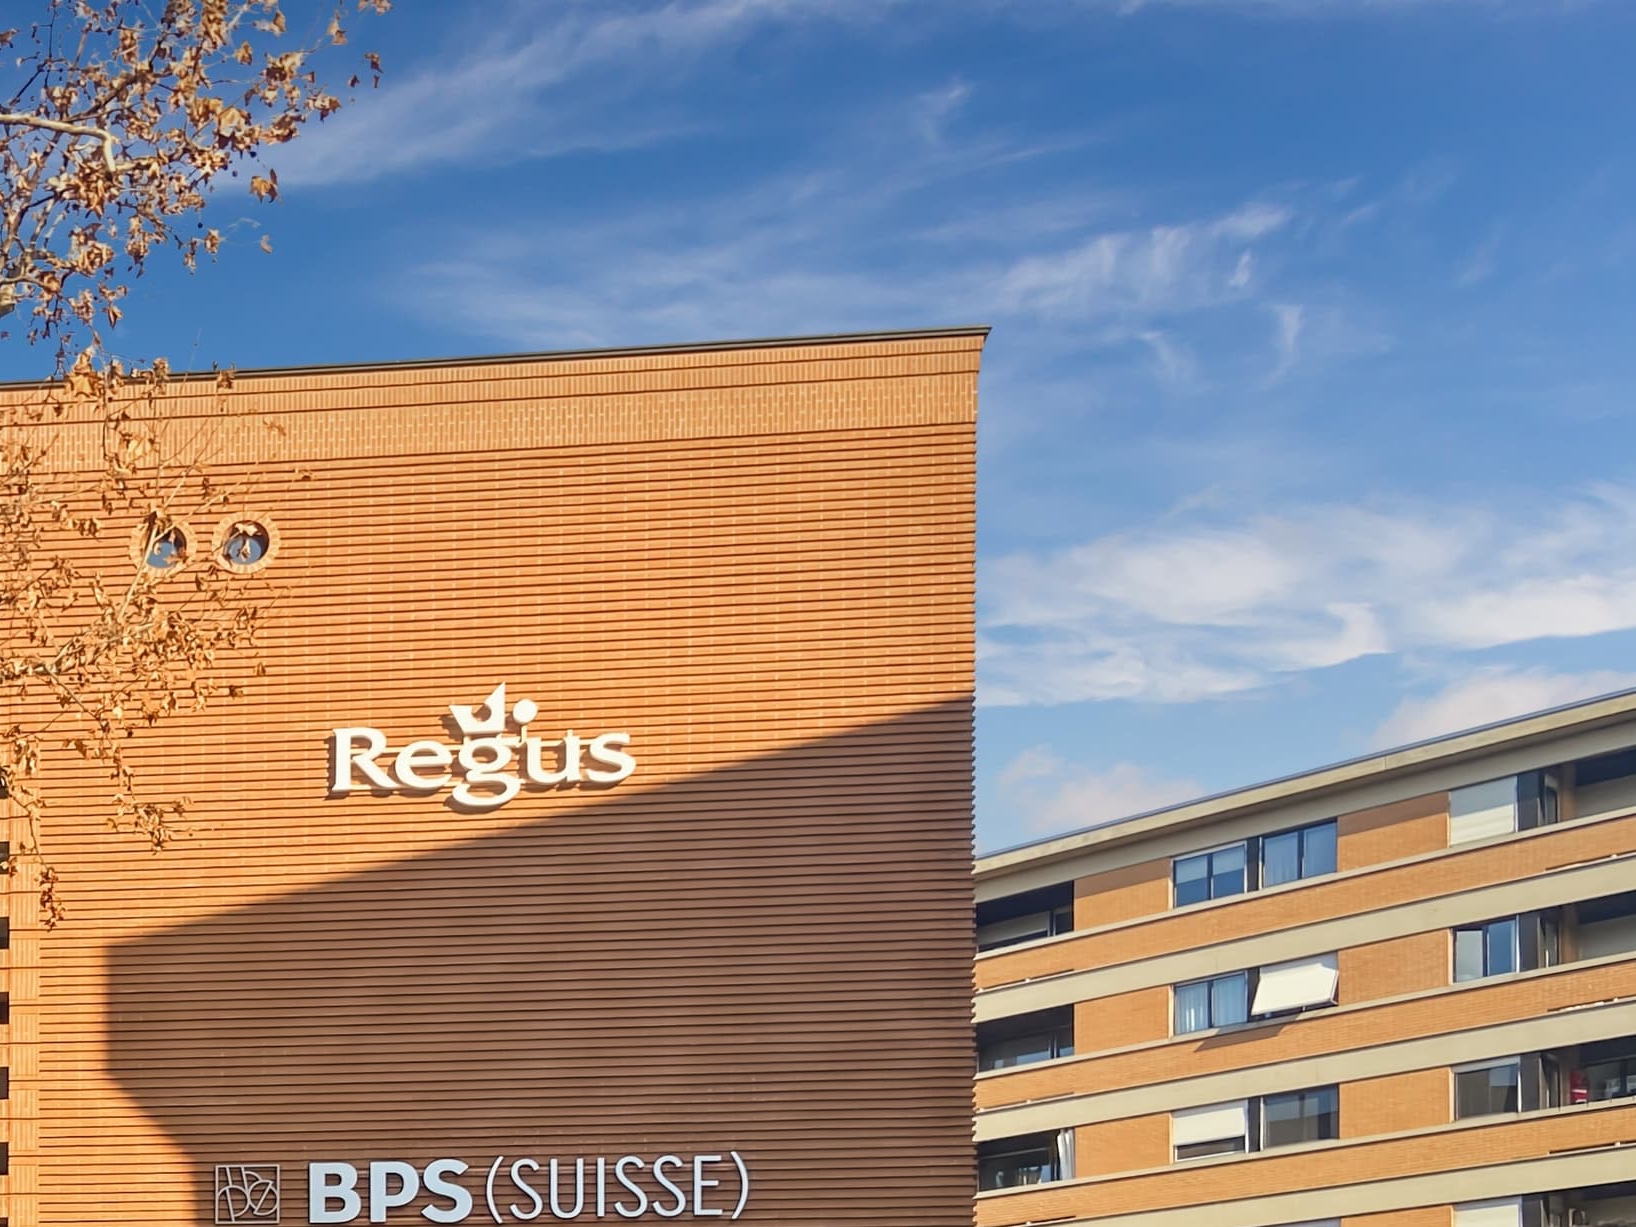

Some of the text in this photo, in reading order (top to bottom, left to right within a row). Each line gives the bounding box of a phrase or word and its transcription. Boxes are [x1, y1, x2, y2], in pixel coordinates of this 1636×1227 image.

[332, 727, 637, 807] Regus
[308, 1158, 474, 1224] BPS
[486, 1151, 749, 1224] (SUISSE)
